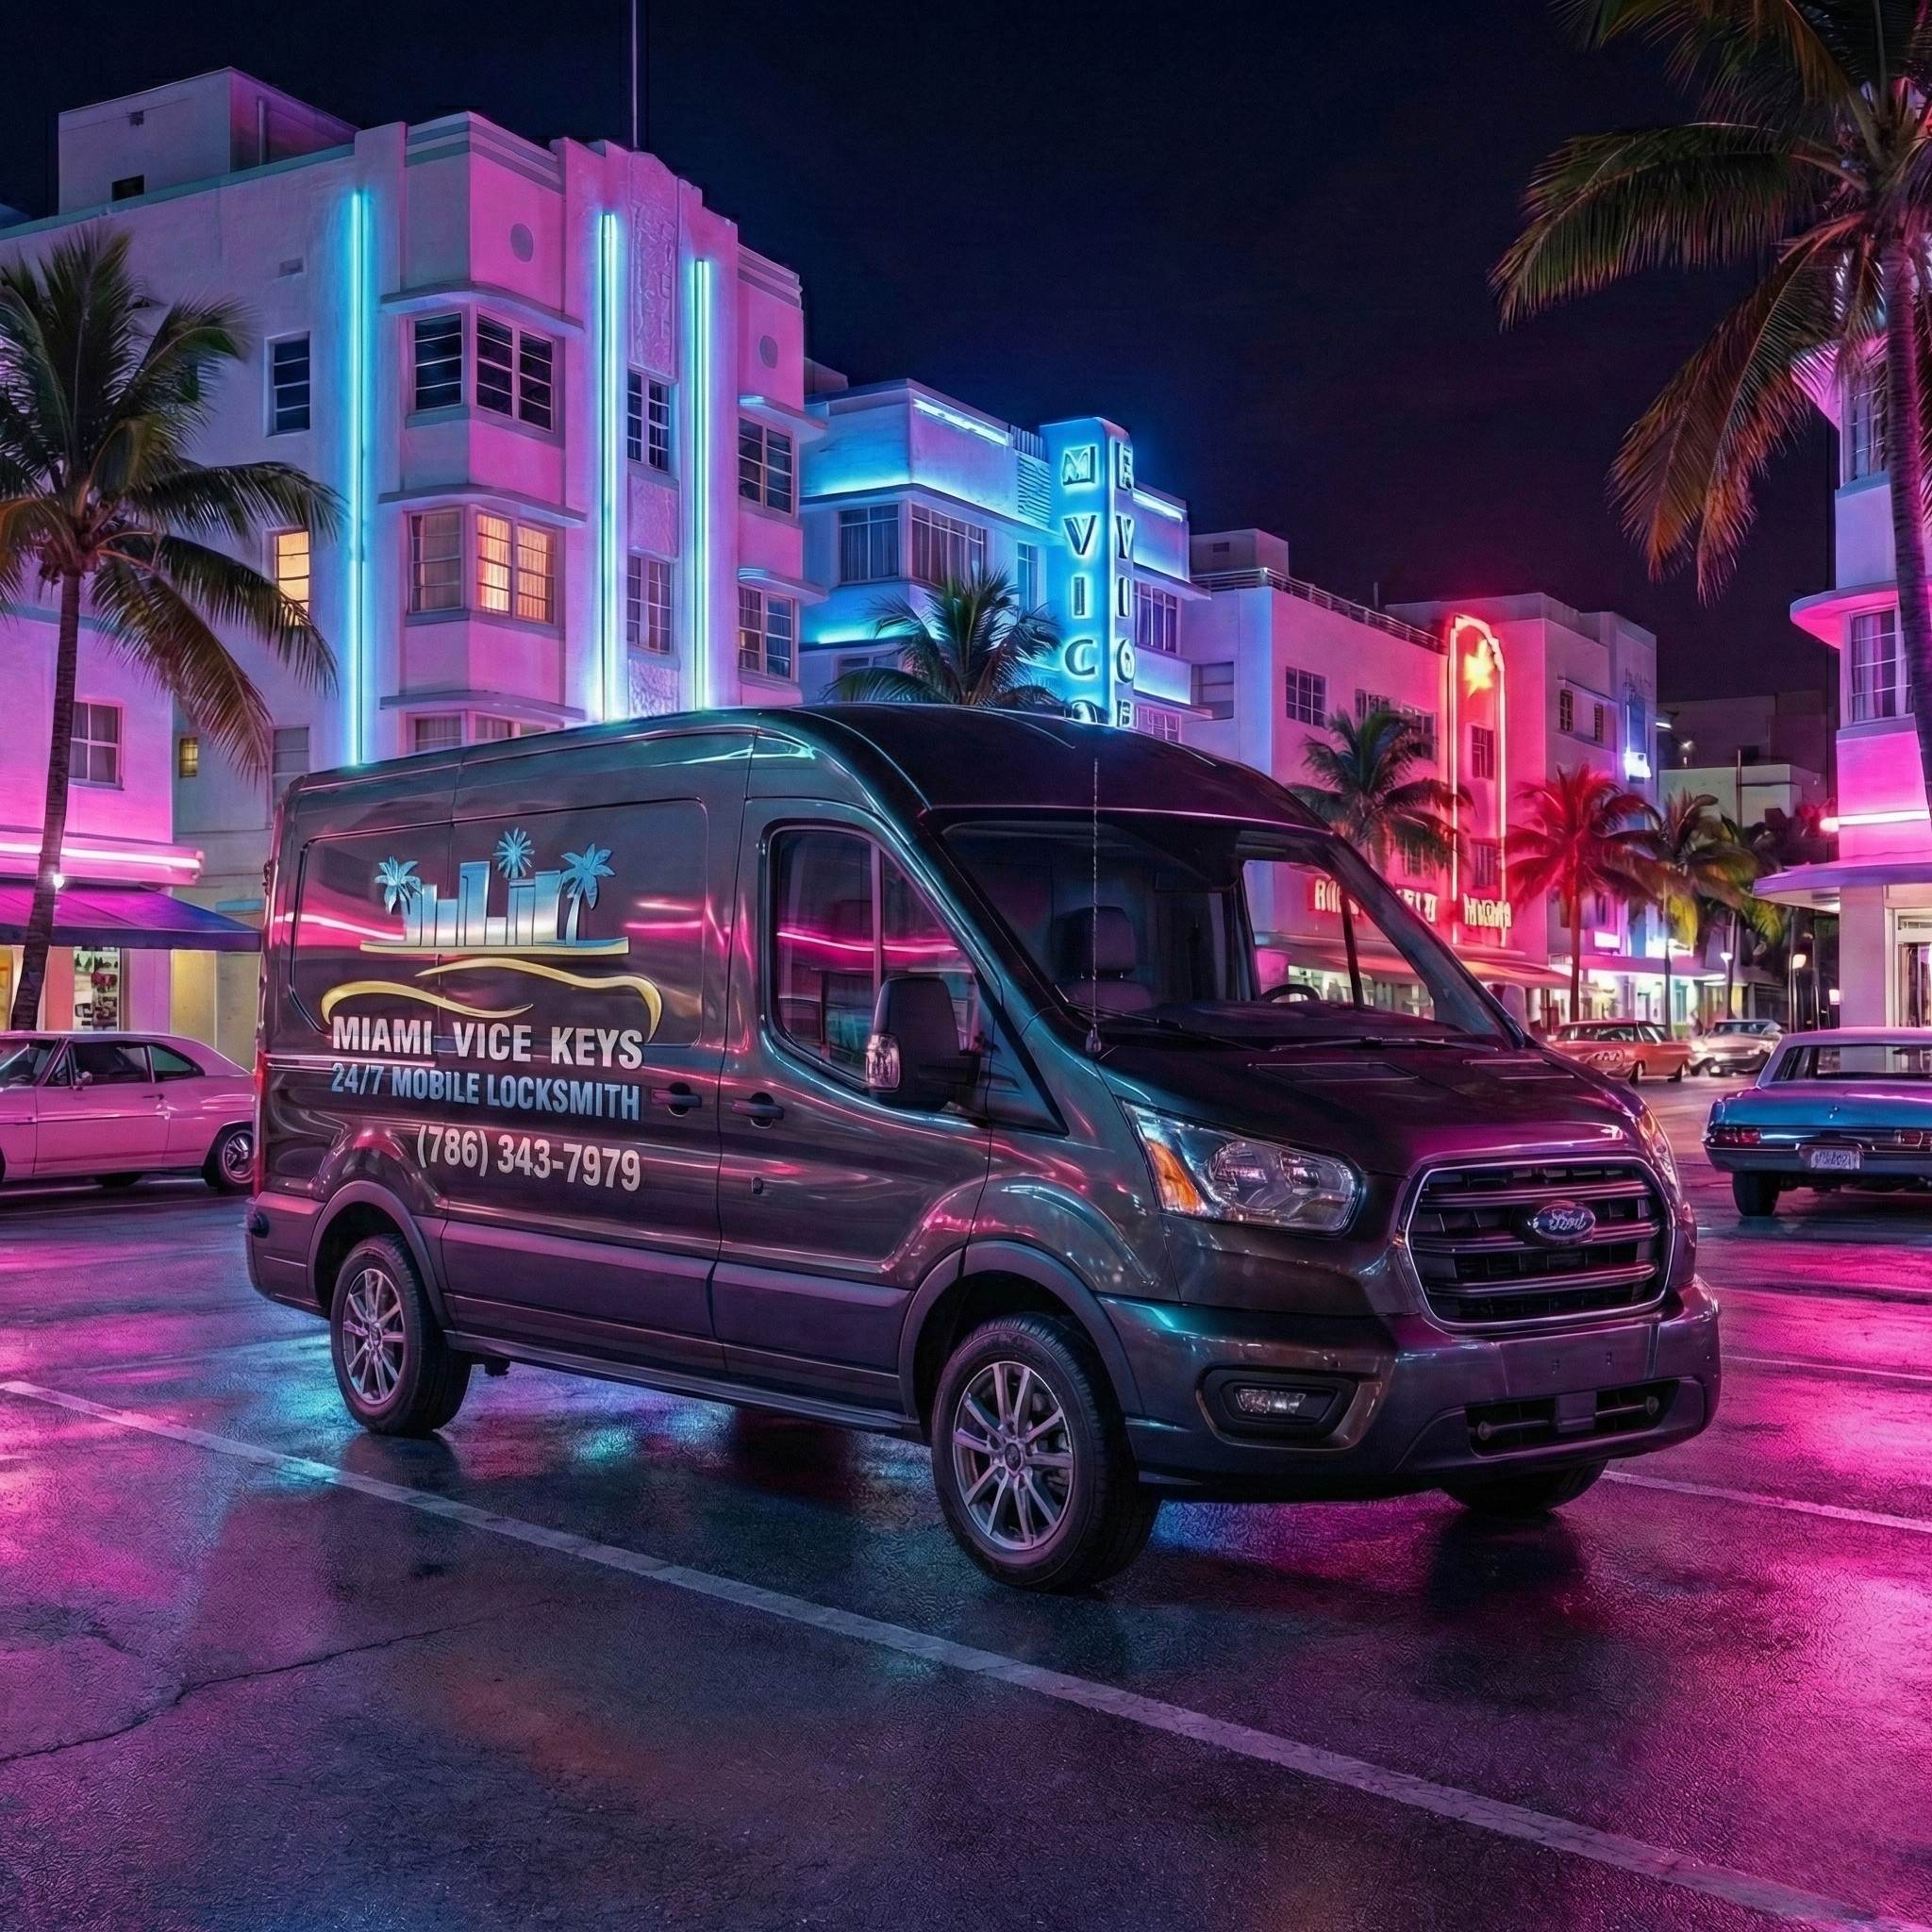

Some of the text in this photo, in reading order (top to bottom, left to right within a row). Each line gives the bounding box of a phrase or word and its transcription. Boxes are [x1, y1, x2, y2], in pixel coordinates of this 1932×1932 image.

[333, 1016, 642, 1069] MIAMI VICE KEYS
[331, 1062, 640, 1121] 24/7 MOBILE LOCKSMITH
[416, 1124, 641, 1191] (786) 343-7979
